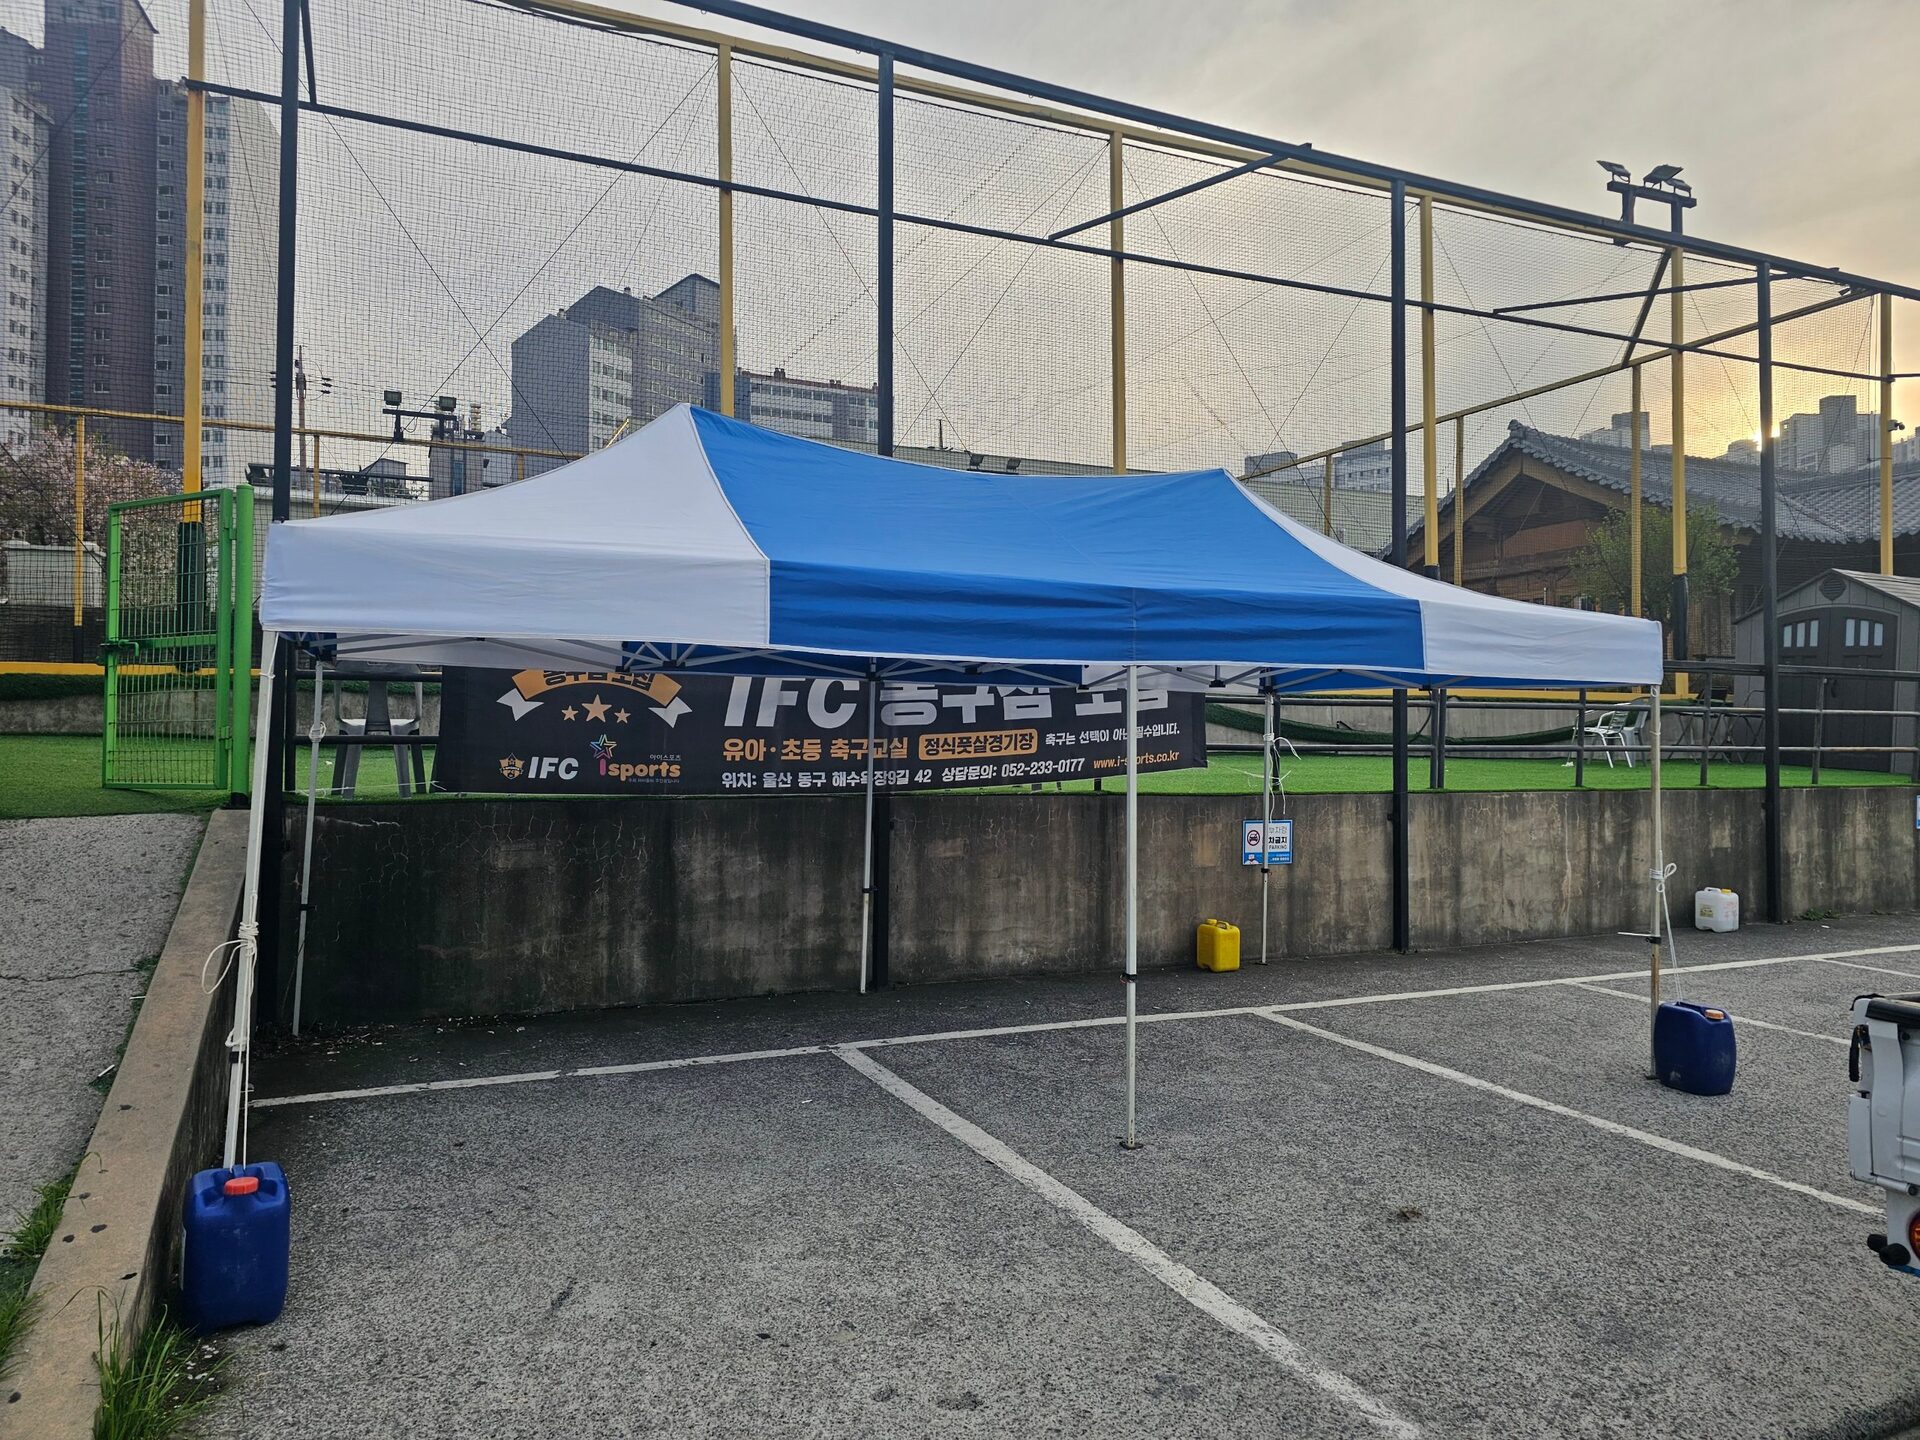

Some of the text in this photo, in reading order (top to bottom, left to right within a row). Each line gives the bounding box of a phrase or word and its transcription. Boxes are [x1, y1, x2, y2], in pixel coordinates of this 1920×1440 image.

[724, 676, 860, 729] IFC
[830, 736, 908, 761] 축구교실
[924, 731, 1034, 757] 정식풋살경기장
[1045, 731, 1076, 747] 축구는
[1079, 729, 1109, 745] 선택이
[528, 756, 579, 780] IFC
[722, 771, 757, 788] 위치:
[763, 771, 793, 788] 울산
[798, 771, 827, 788] 동구
[914, 769, 932, 783] 42
[942, 764, 997, 782] 상담문의:
[1001, 757, 1086, 778] 052-233-0177
[1093, 749, 1180, 769] www.i-sorts.co.kr
